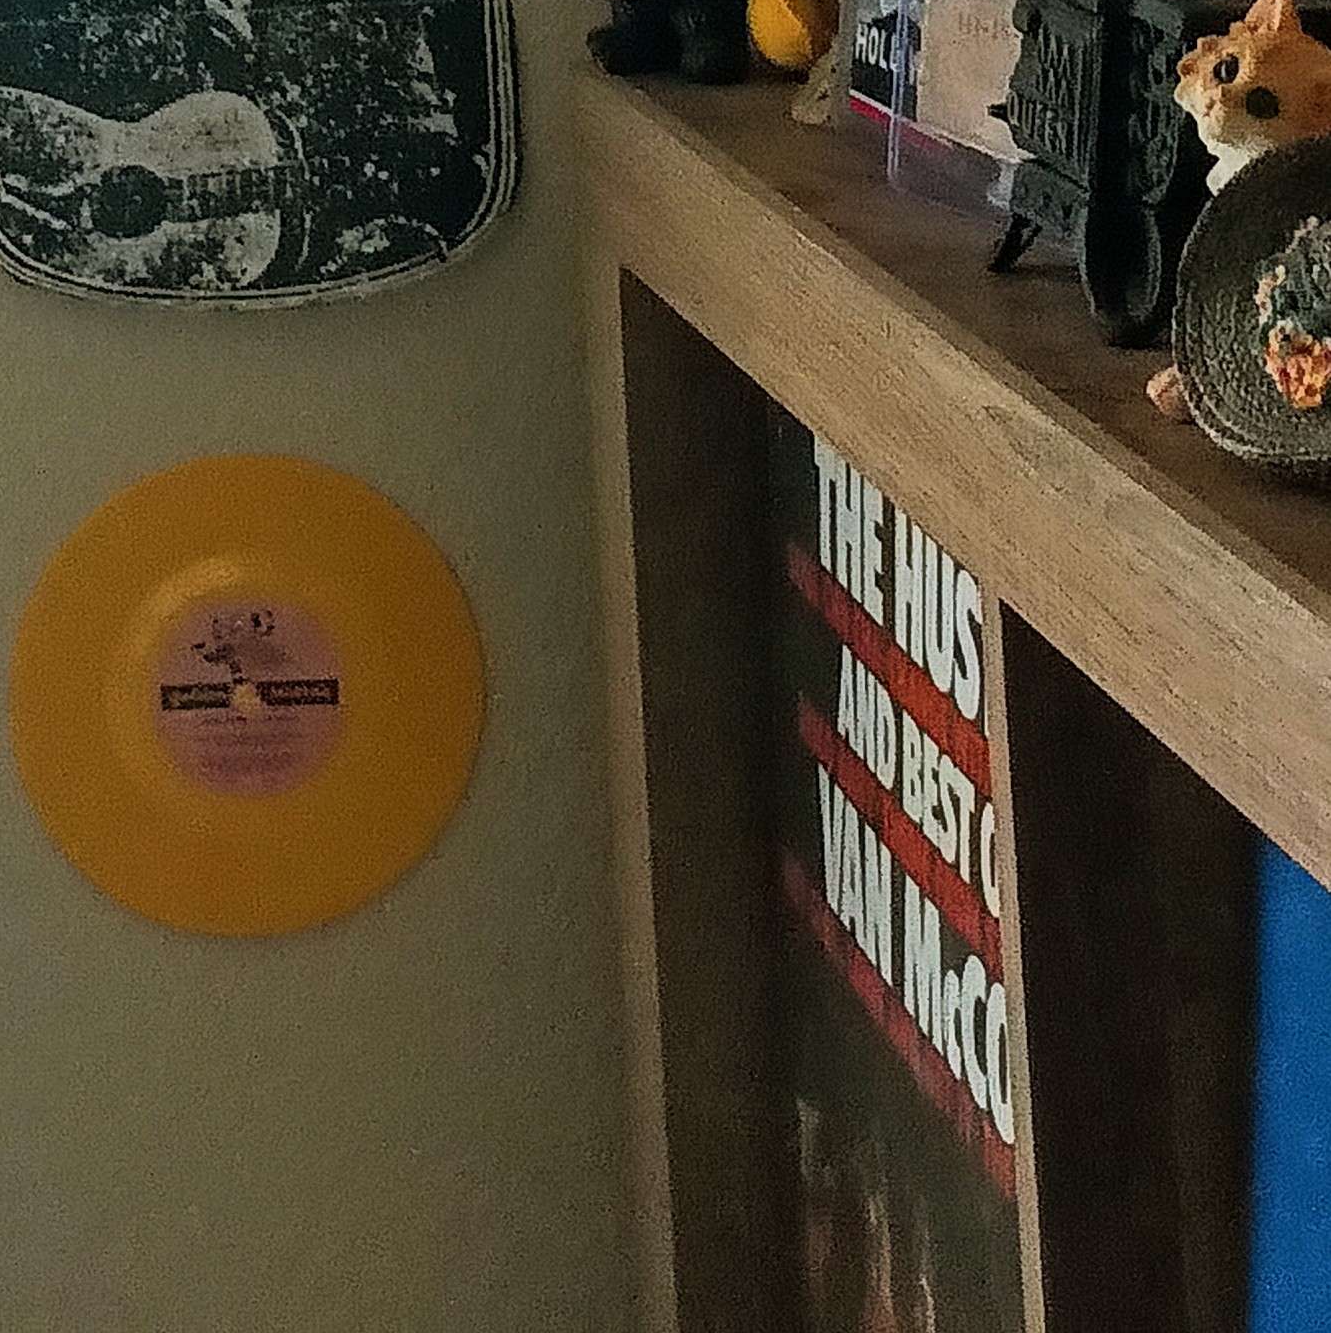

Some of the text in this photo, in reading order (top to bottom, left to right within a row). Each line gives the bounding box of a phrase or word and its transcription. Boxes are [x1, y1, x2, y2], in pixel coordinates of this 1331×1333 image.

[855, 22, 916, 85] HOLL
[815, 433, 987, 725] THE HUS
[818, 764, 892, 987] VAN
[838, 644, 896, 791] AND
[902, 710, 975, 885] BEST
